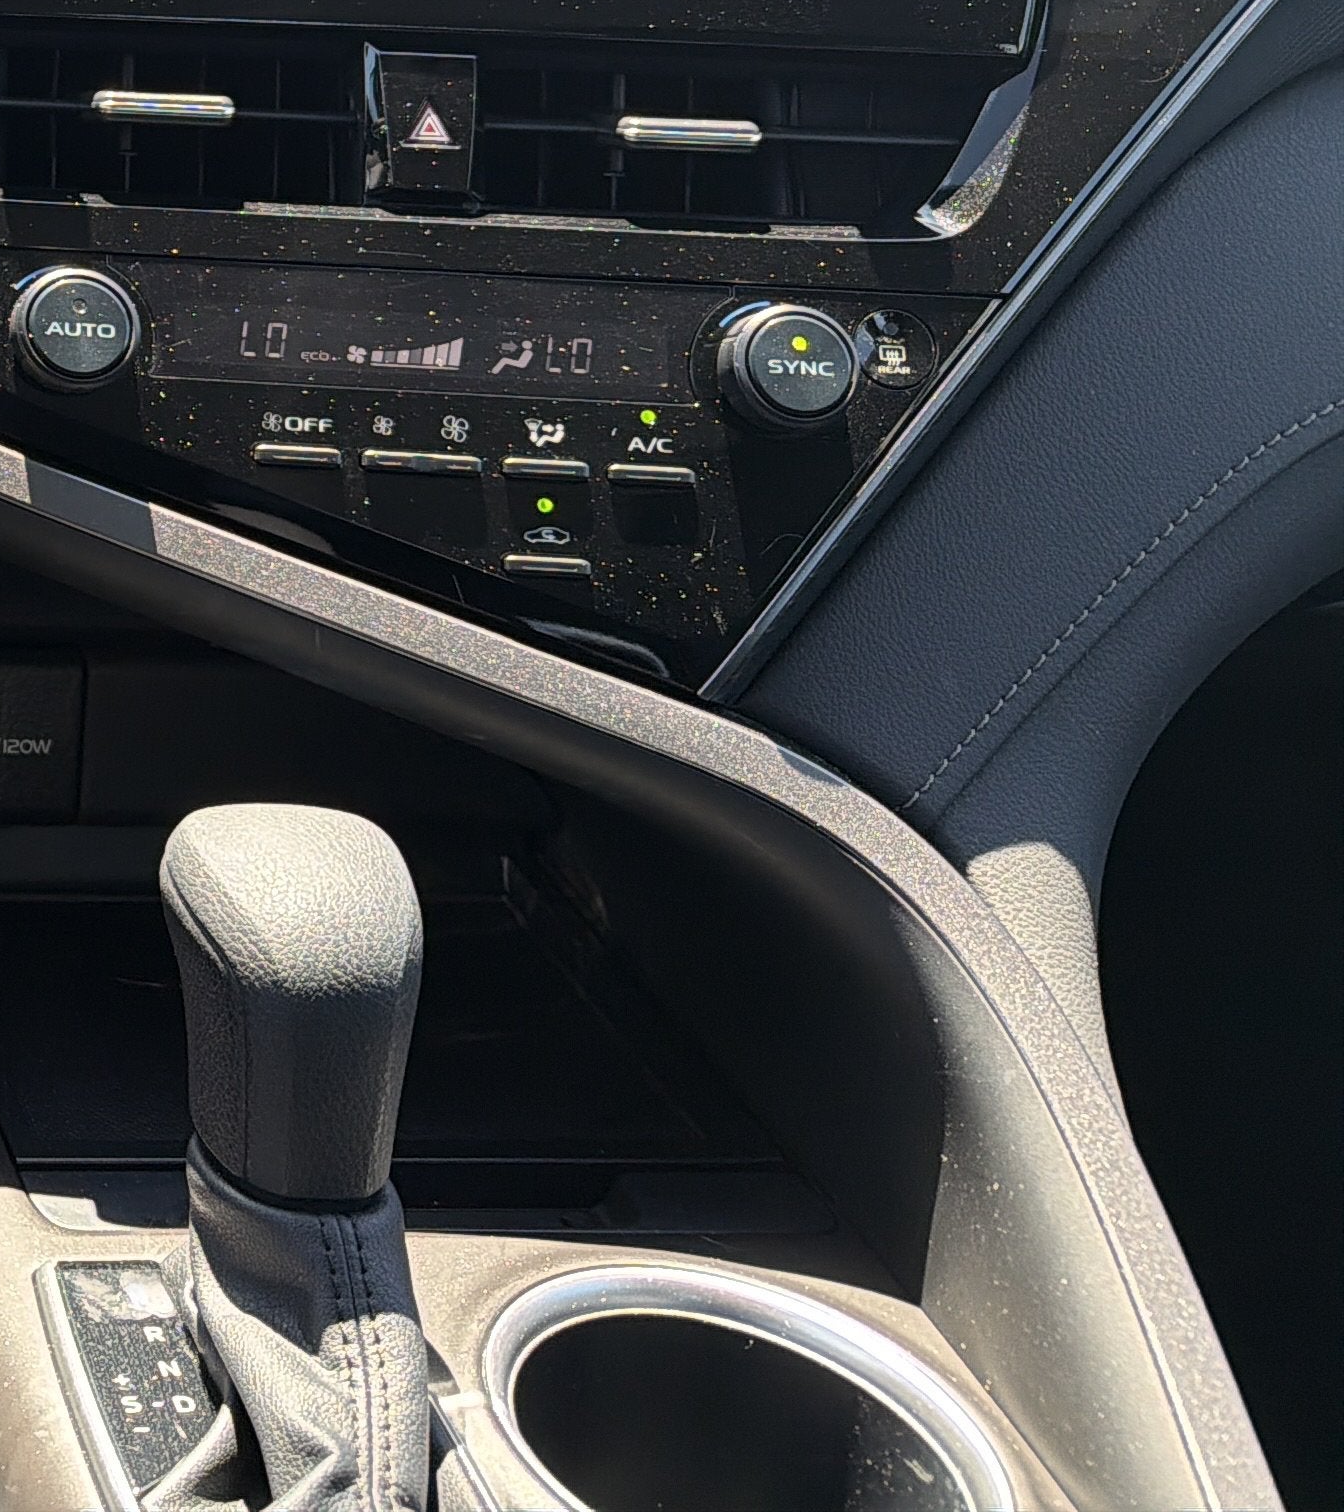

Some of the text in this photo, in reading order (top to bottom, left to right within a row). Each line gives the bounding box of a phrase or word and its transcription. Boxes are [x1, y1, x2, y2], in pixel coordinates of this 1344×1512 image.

[45, 320, 116, 340] AUTO
[300, 350, 330, 362] ECO
[768, 359, 835, 377] SYNC
[284, 416, 334, 433] OFF
[628, 436, 674, 454] A/C
[143, 1326, 165, 1343] R
[157, 1360, 183, 1378] N
[120, 1395, 143, 1414] S
[172, 1395, 197, 1413] D
